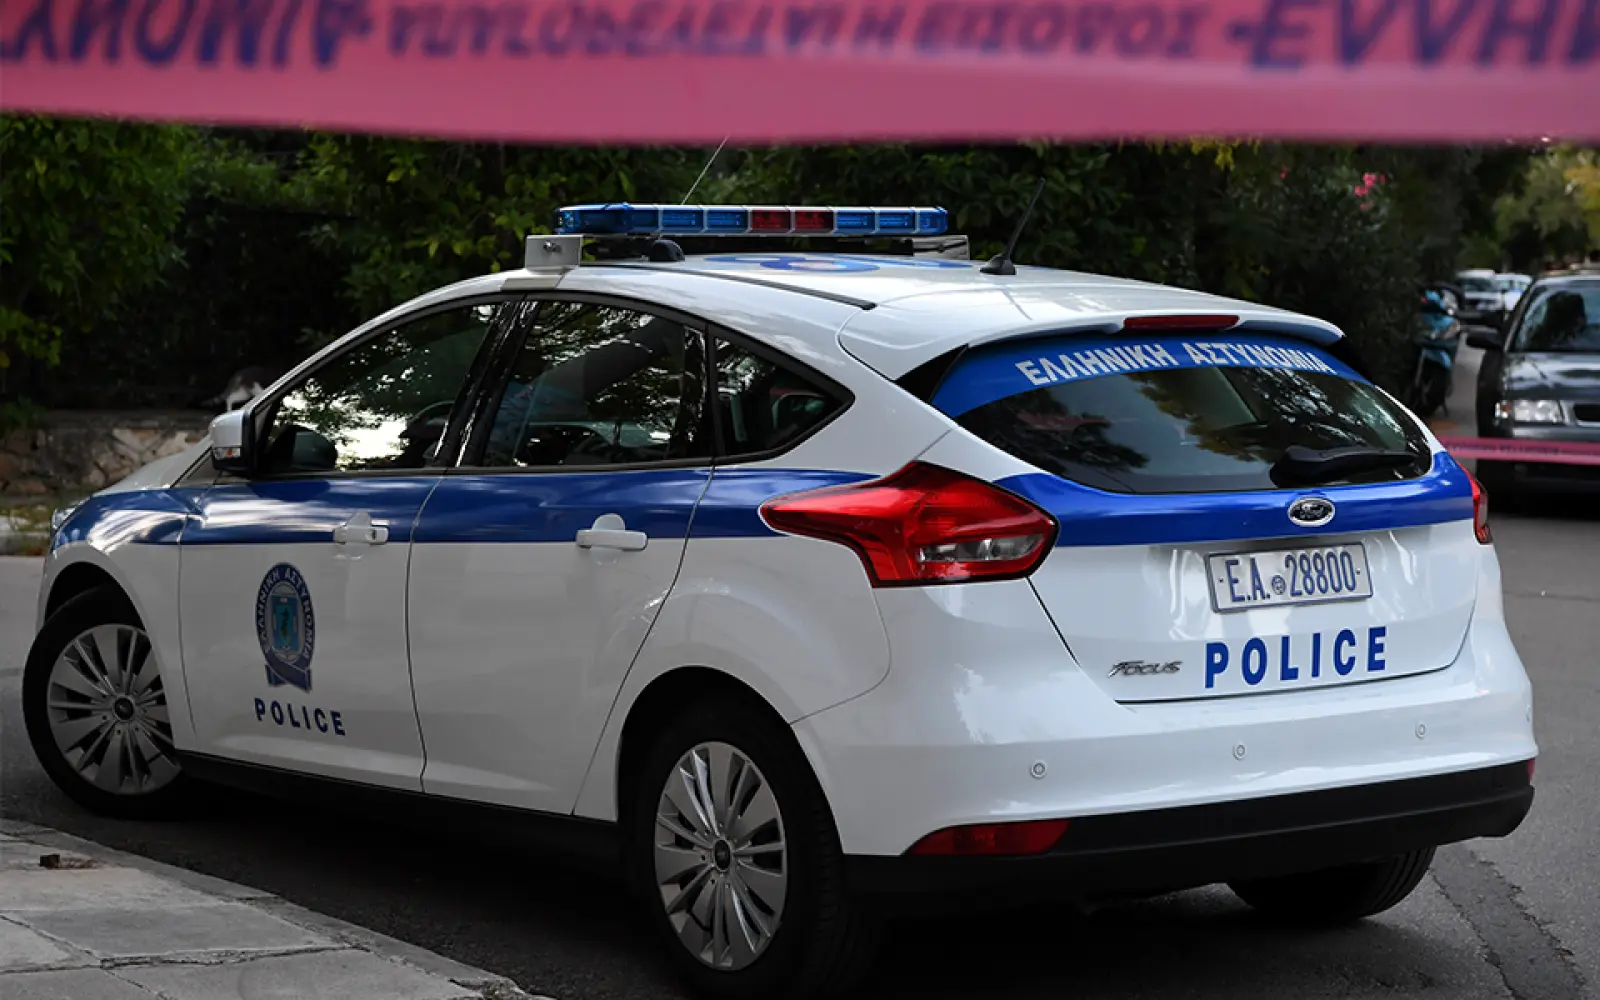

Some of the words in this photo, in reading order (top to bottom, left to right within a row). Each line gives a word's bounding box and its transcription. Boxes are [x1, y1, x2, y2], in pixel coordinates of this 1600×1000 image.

[1015, 344, 1180, 386] ΕΛΛΗΝΙΚΗ
[1181, 341, 1337, 375] ΑΣΤΥΝΟΜΙΑ
[1285, 551, 1357, 597] 28800
[1204, 626, 1387, 689] POLICE
[254, 697, 346, 736] POLICE
